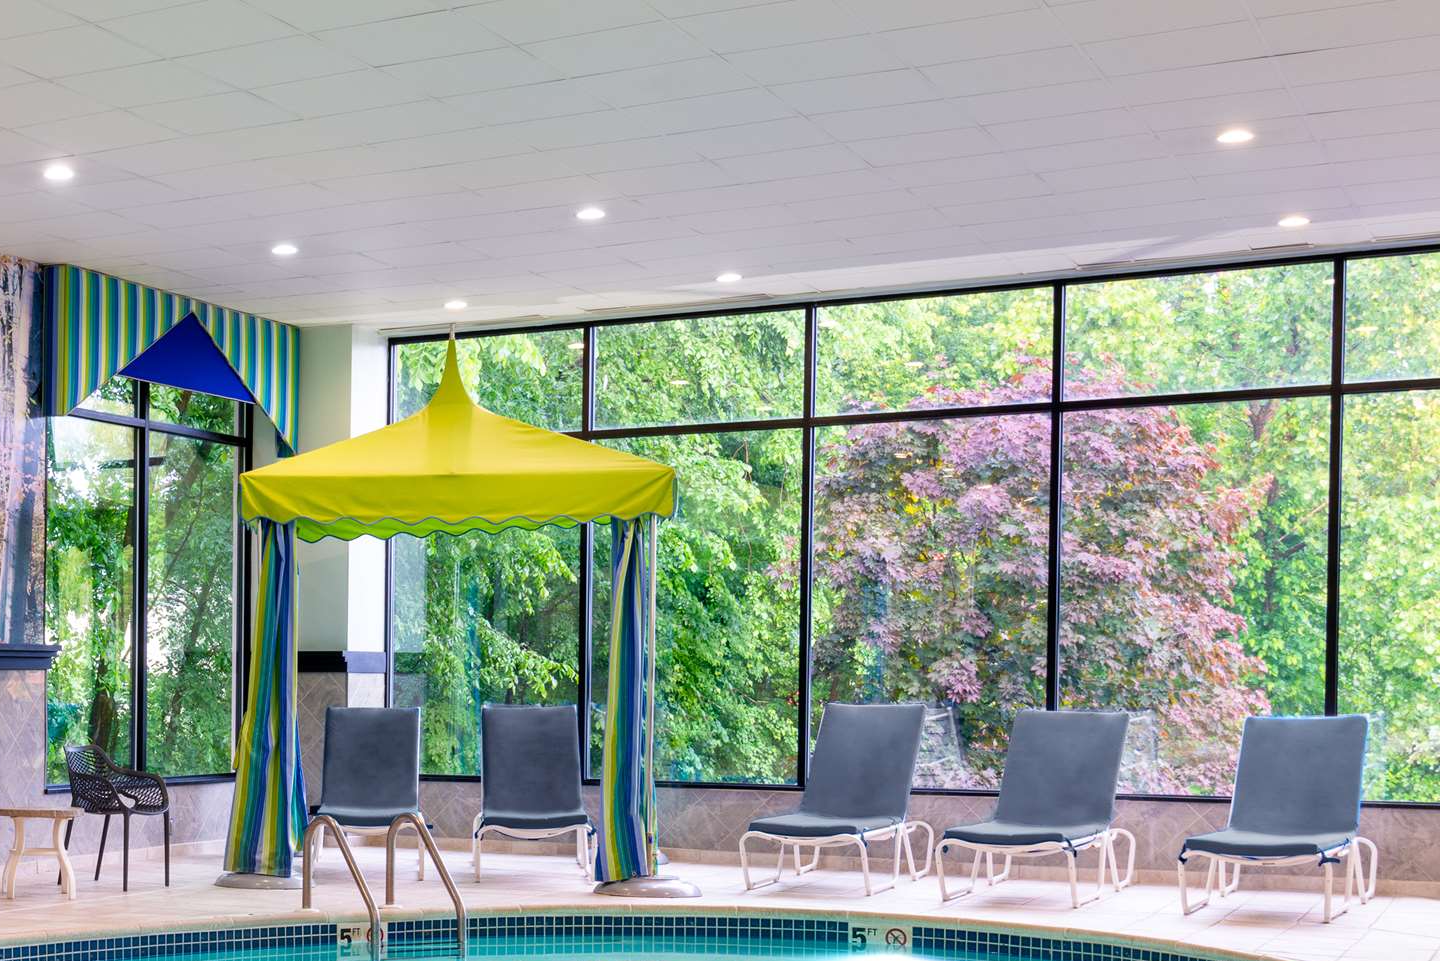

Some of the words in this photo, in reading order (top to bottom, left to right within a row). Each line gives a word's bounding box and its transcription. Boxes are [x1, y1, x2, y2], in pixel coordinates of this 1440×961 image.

[340, 928, 352, 944] 5
[851, 926, 867, 944] 5
[867, 927, 878, 937] FT
